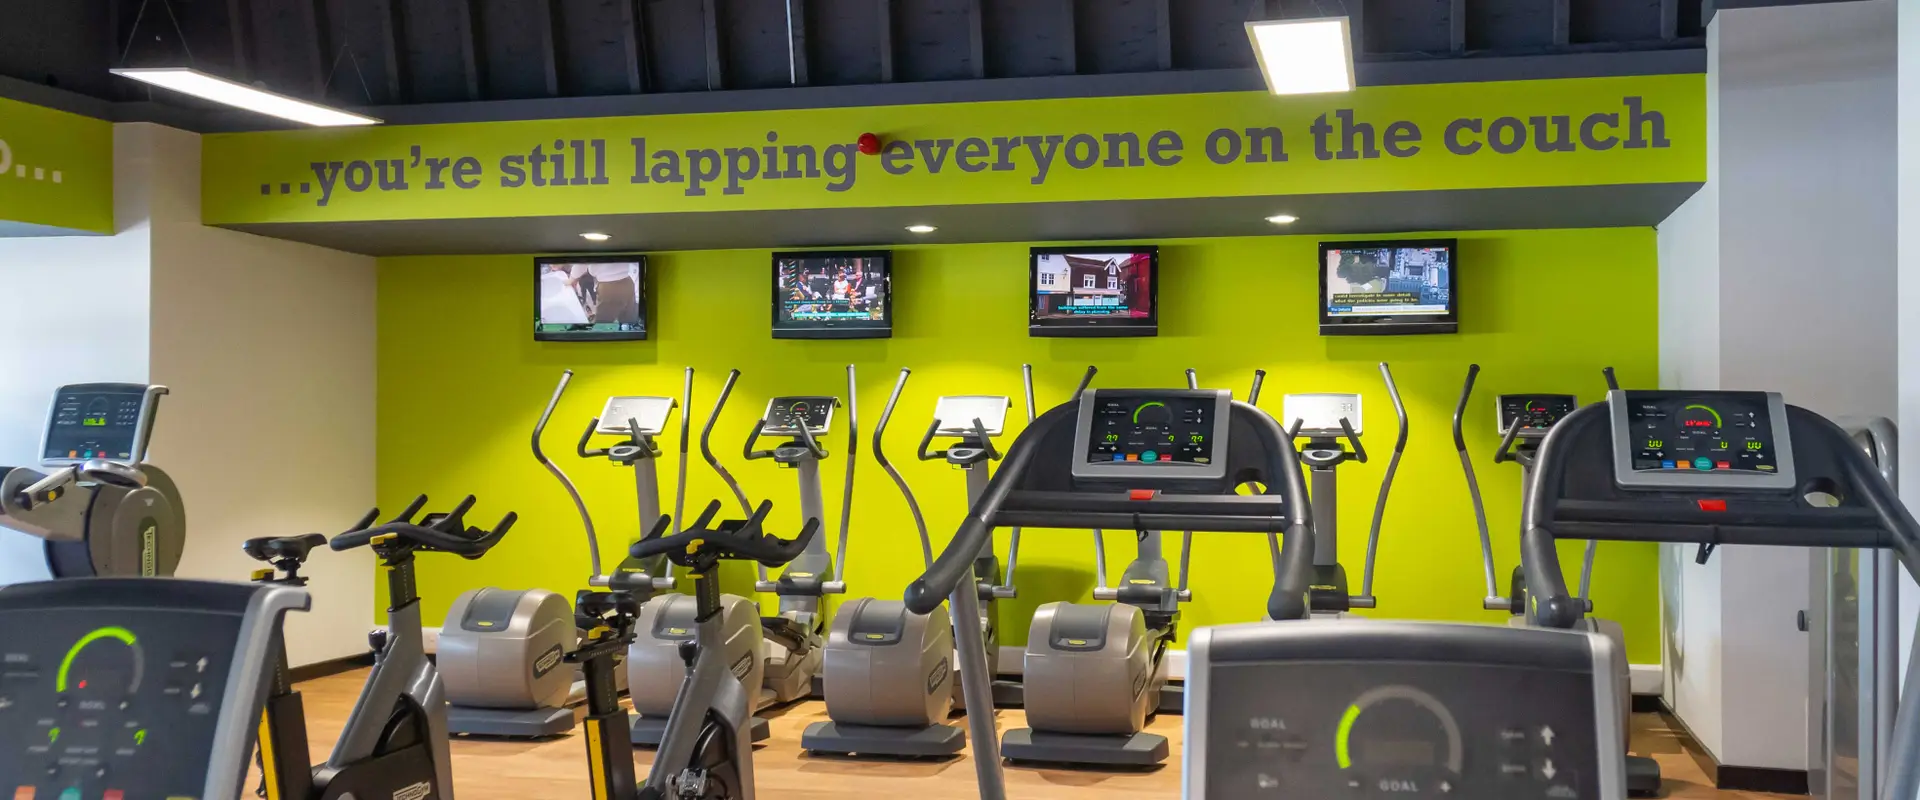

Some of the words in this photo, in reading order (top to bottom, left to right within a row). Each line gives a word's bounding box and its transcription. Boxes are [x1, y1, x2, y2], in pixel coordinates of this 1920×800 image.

[261, 145, 483, 207] ...you're
[500, 138, 609, 188] still
[630, 130, 860, 196] lapping
[880, 127, 1184, 185] everyone
[1204, 124, 1289, 165] on
[1310, 108, 1422, 161] the
[1443, 95, 1671, 156] couch
[1378, 779, 1419, 792] GOAL
